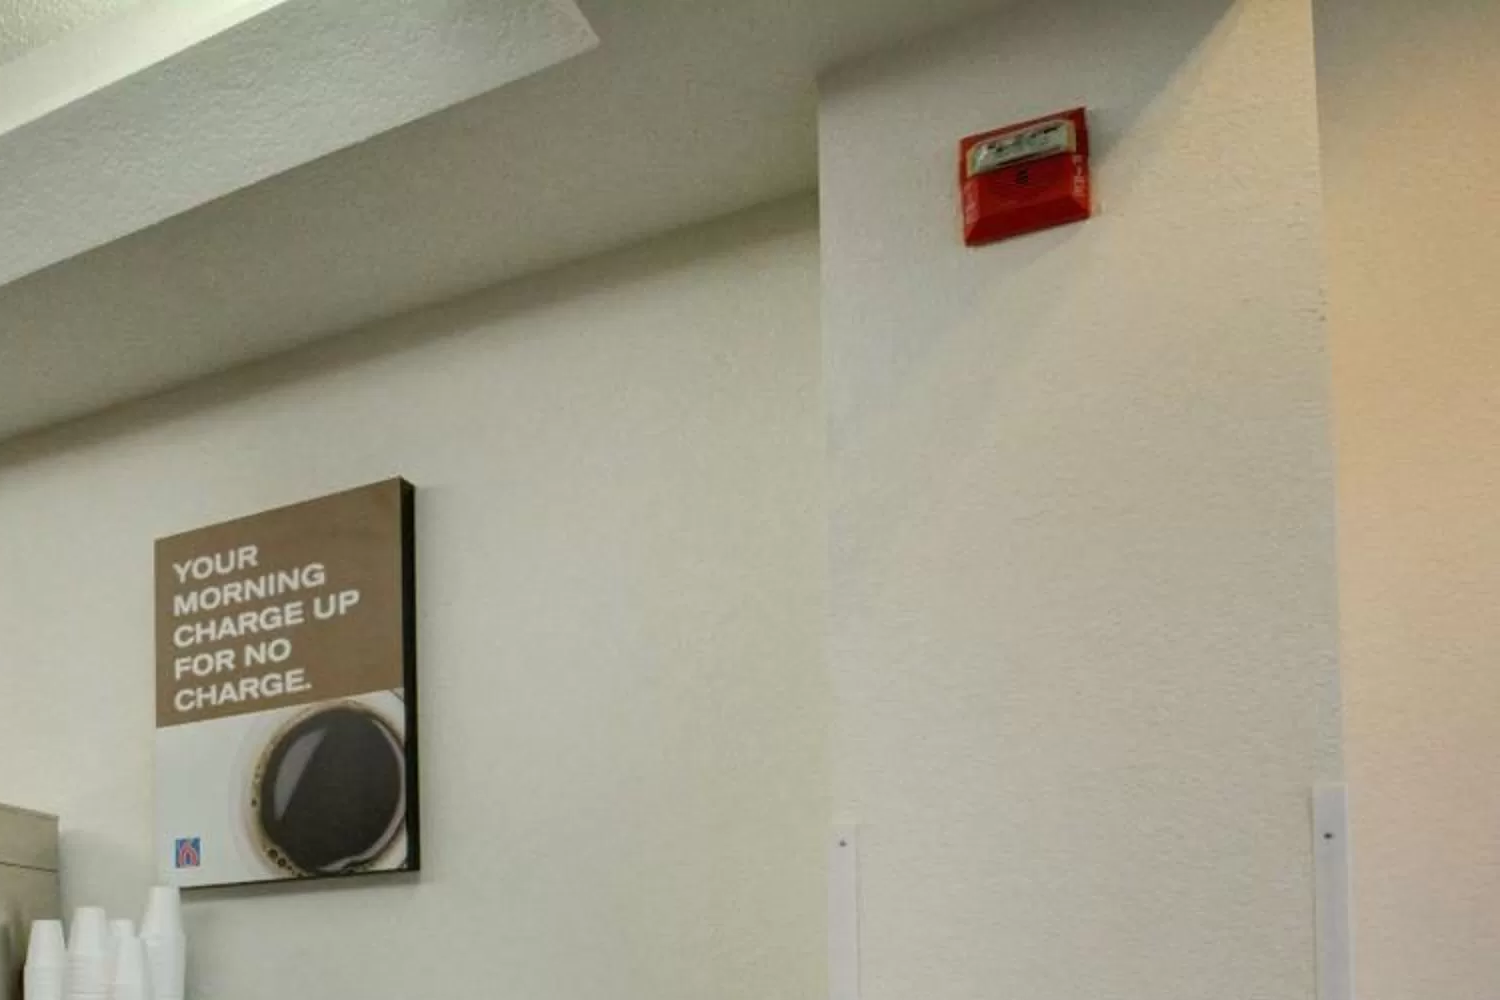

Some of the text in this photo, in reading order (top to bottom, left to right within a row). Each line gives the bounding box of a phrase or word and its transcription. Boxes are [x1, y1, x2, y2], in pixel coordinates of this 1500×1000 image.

[172, 544, 258, 584] YOUR
[173, 563, 326, 617] MORNING
[173, 589, 360, 648] CHARGE UP
[175, 638, 292, 680] FOR NO
[174, 668, 312, 713] CHARGE.
